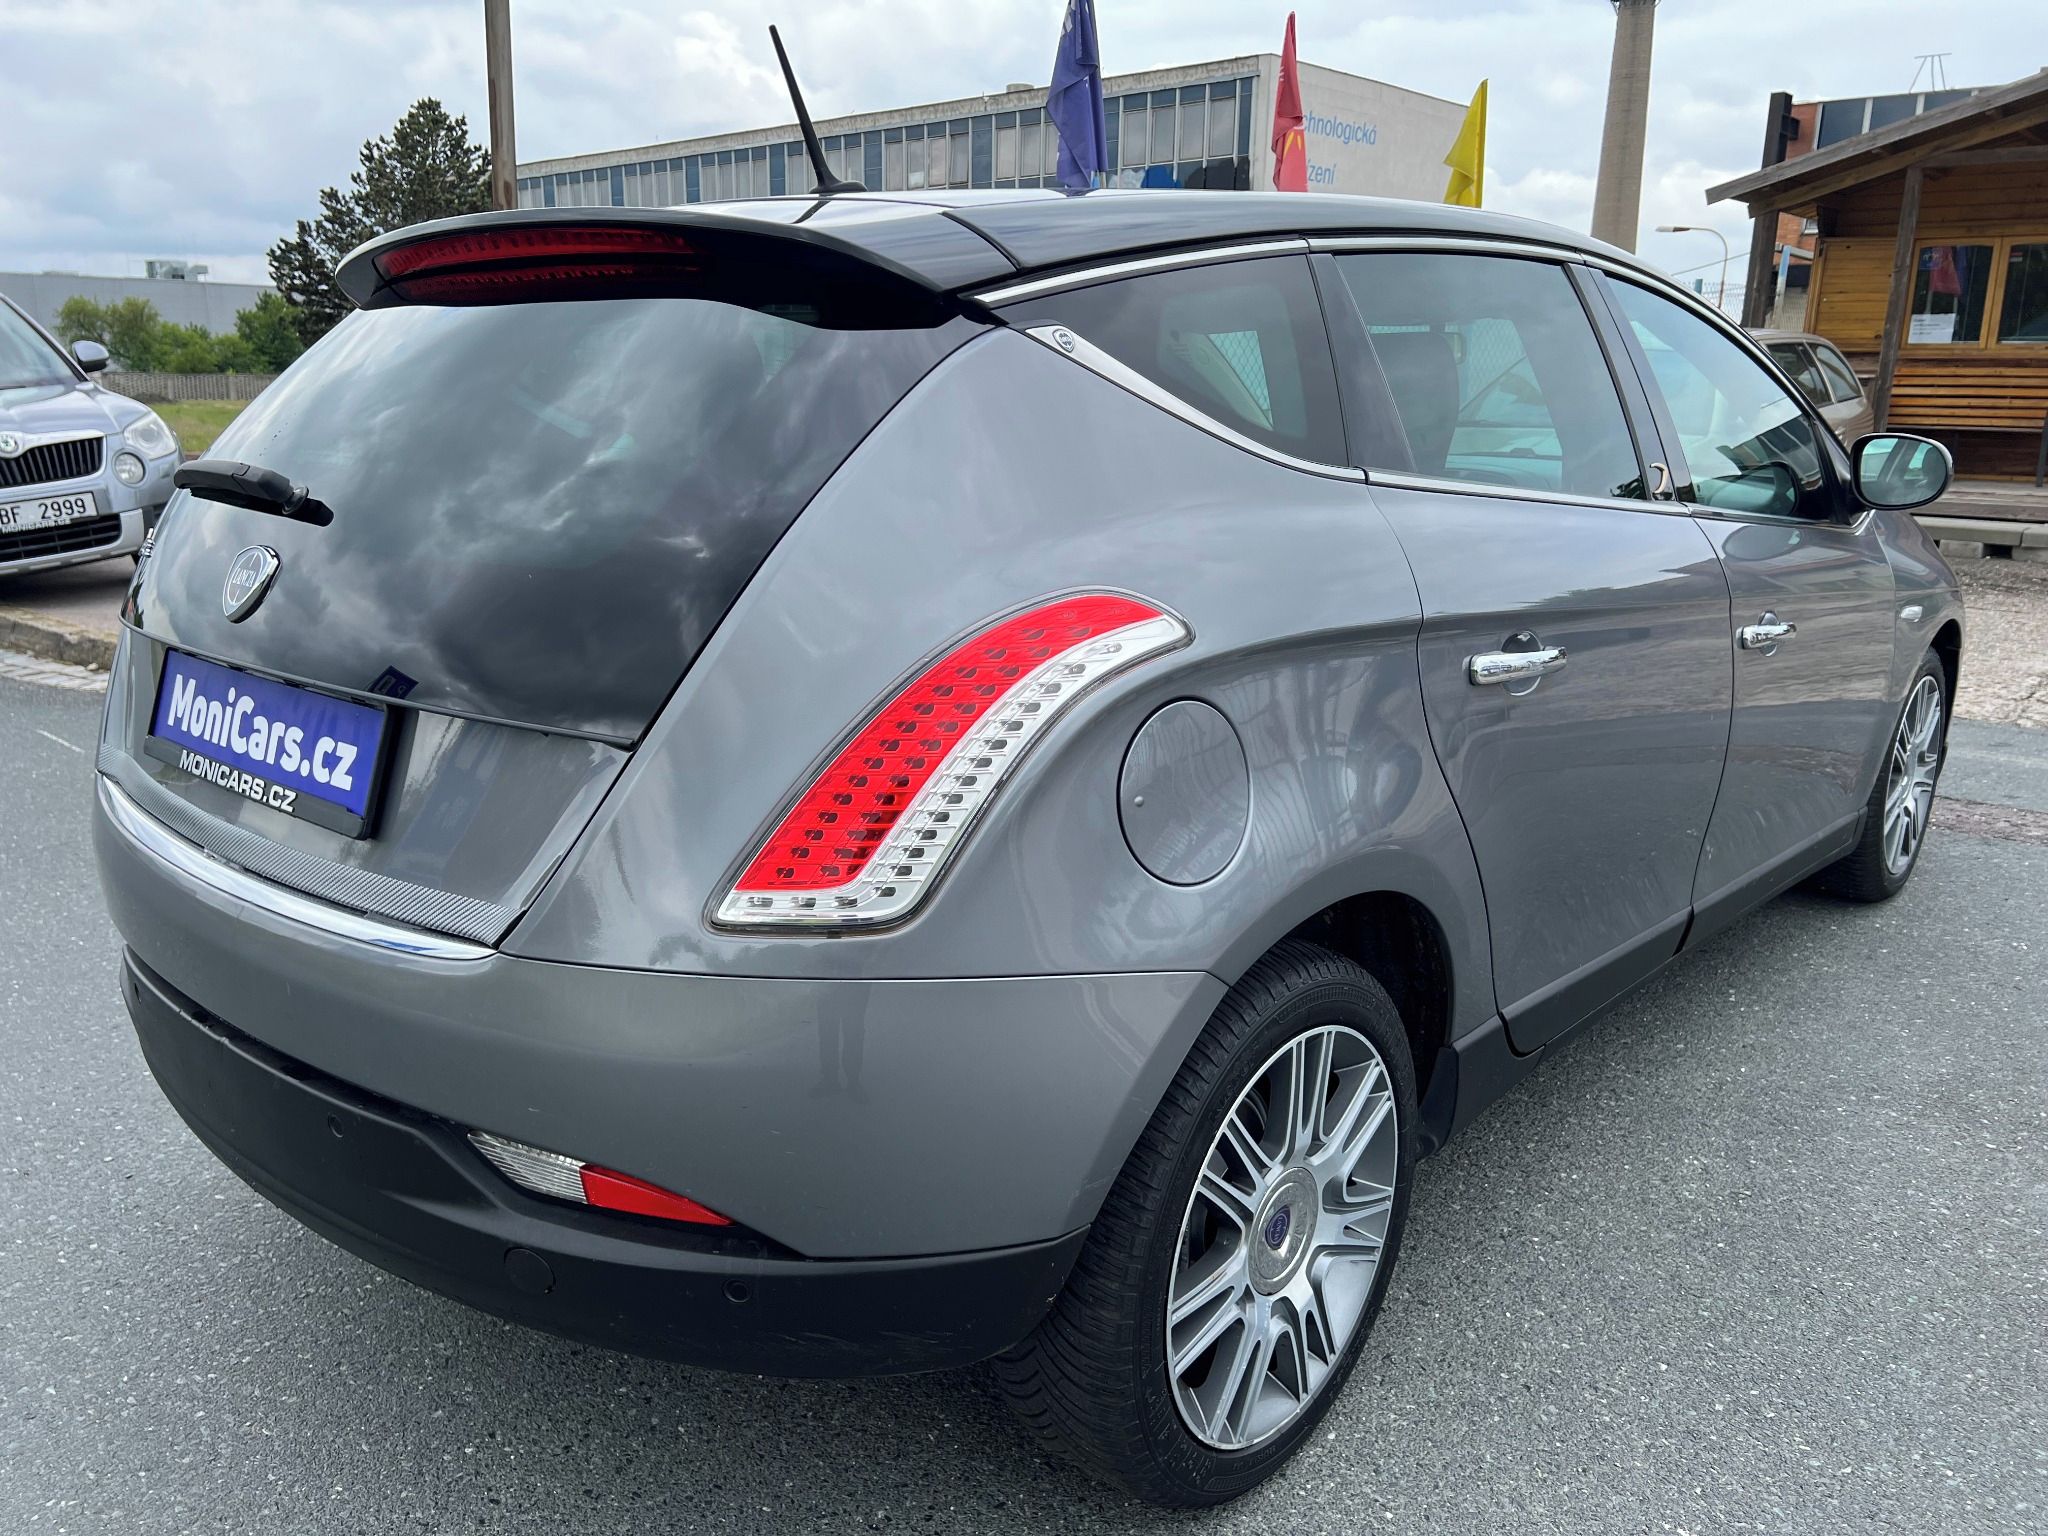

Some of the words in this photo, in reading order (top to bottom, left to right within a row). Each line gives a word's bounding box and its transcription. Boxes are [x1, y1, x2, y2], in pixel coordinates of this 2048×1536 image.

[0, 506, 20, 525] BF
[39, 498, 87, 520] 2999
[167, 673, 358, 791] MoniCars.cz
[179, 750, 298, 813] MONICARS.CZ
